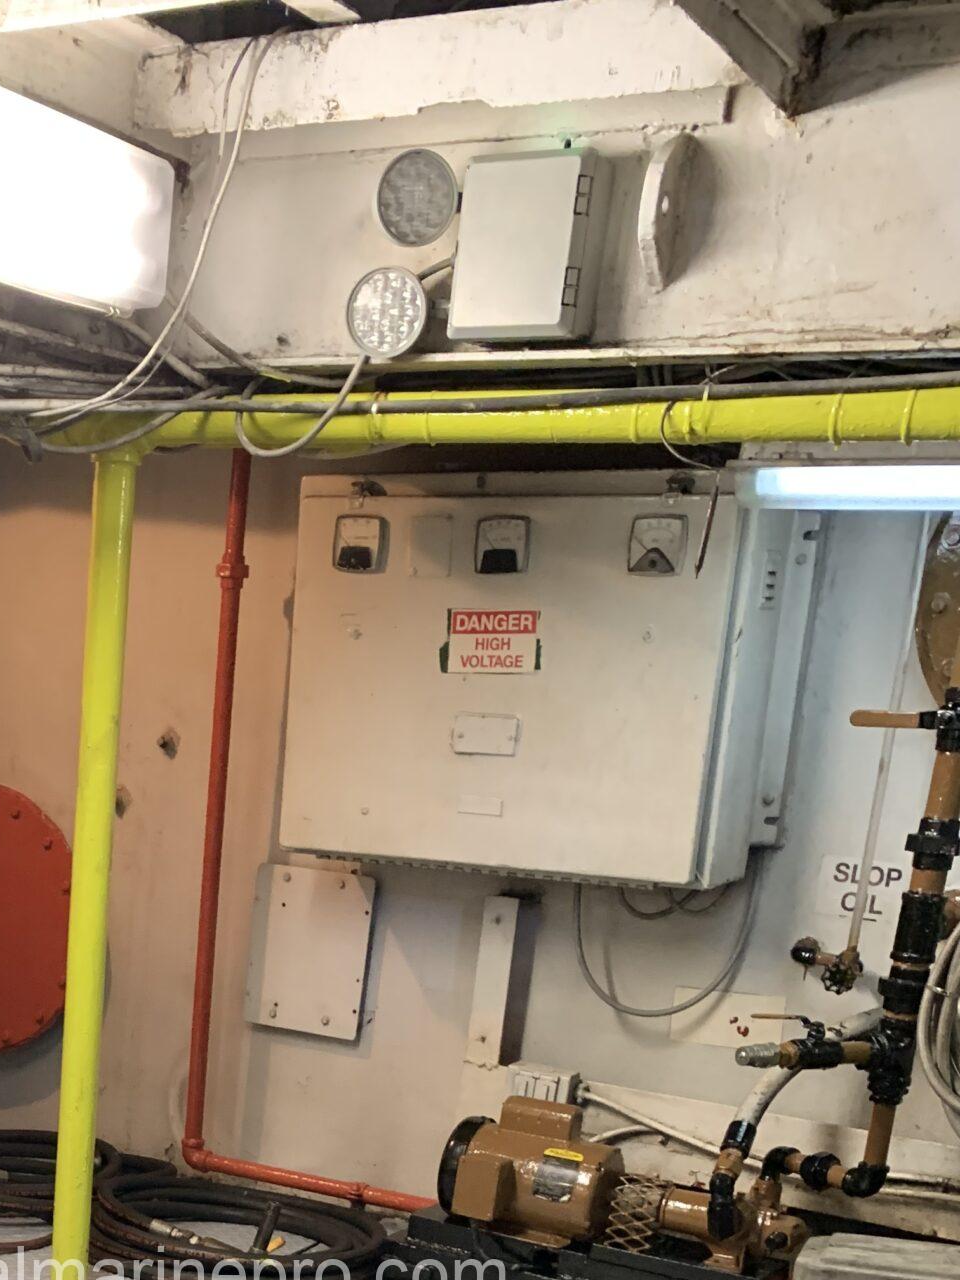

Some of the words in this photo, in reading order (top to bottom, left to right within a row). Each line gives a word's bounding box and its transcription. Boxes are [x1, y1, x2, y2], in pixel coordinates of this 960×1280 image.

[455, 613, 533, 632] DANGER
[475, 637, 512, 651] HIGH
[460, 654, 525, 669] VOLTAGE
[833, 862, 903, 888] SLOP
[840, 891, 883, 915] OL
